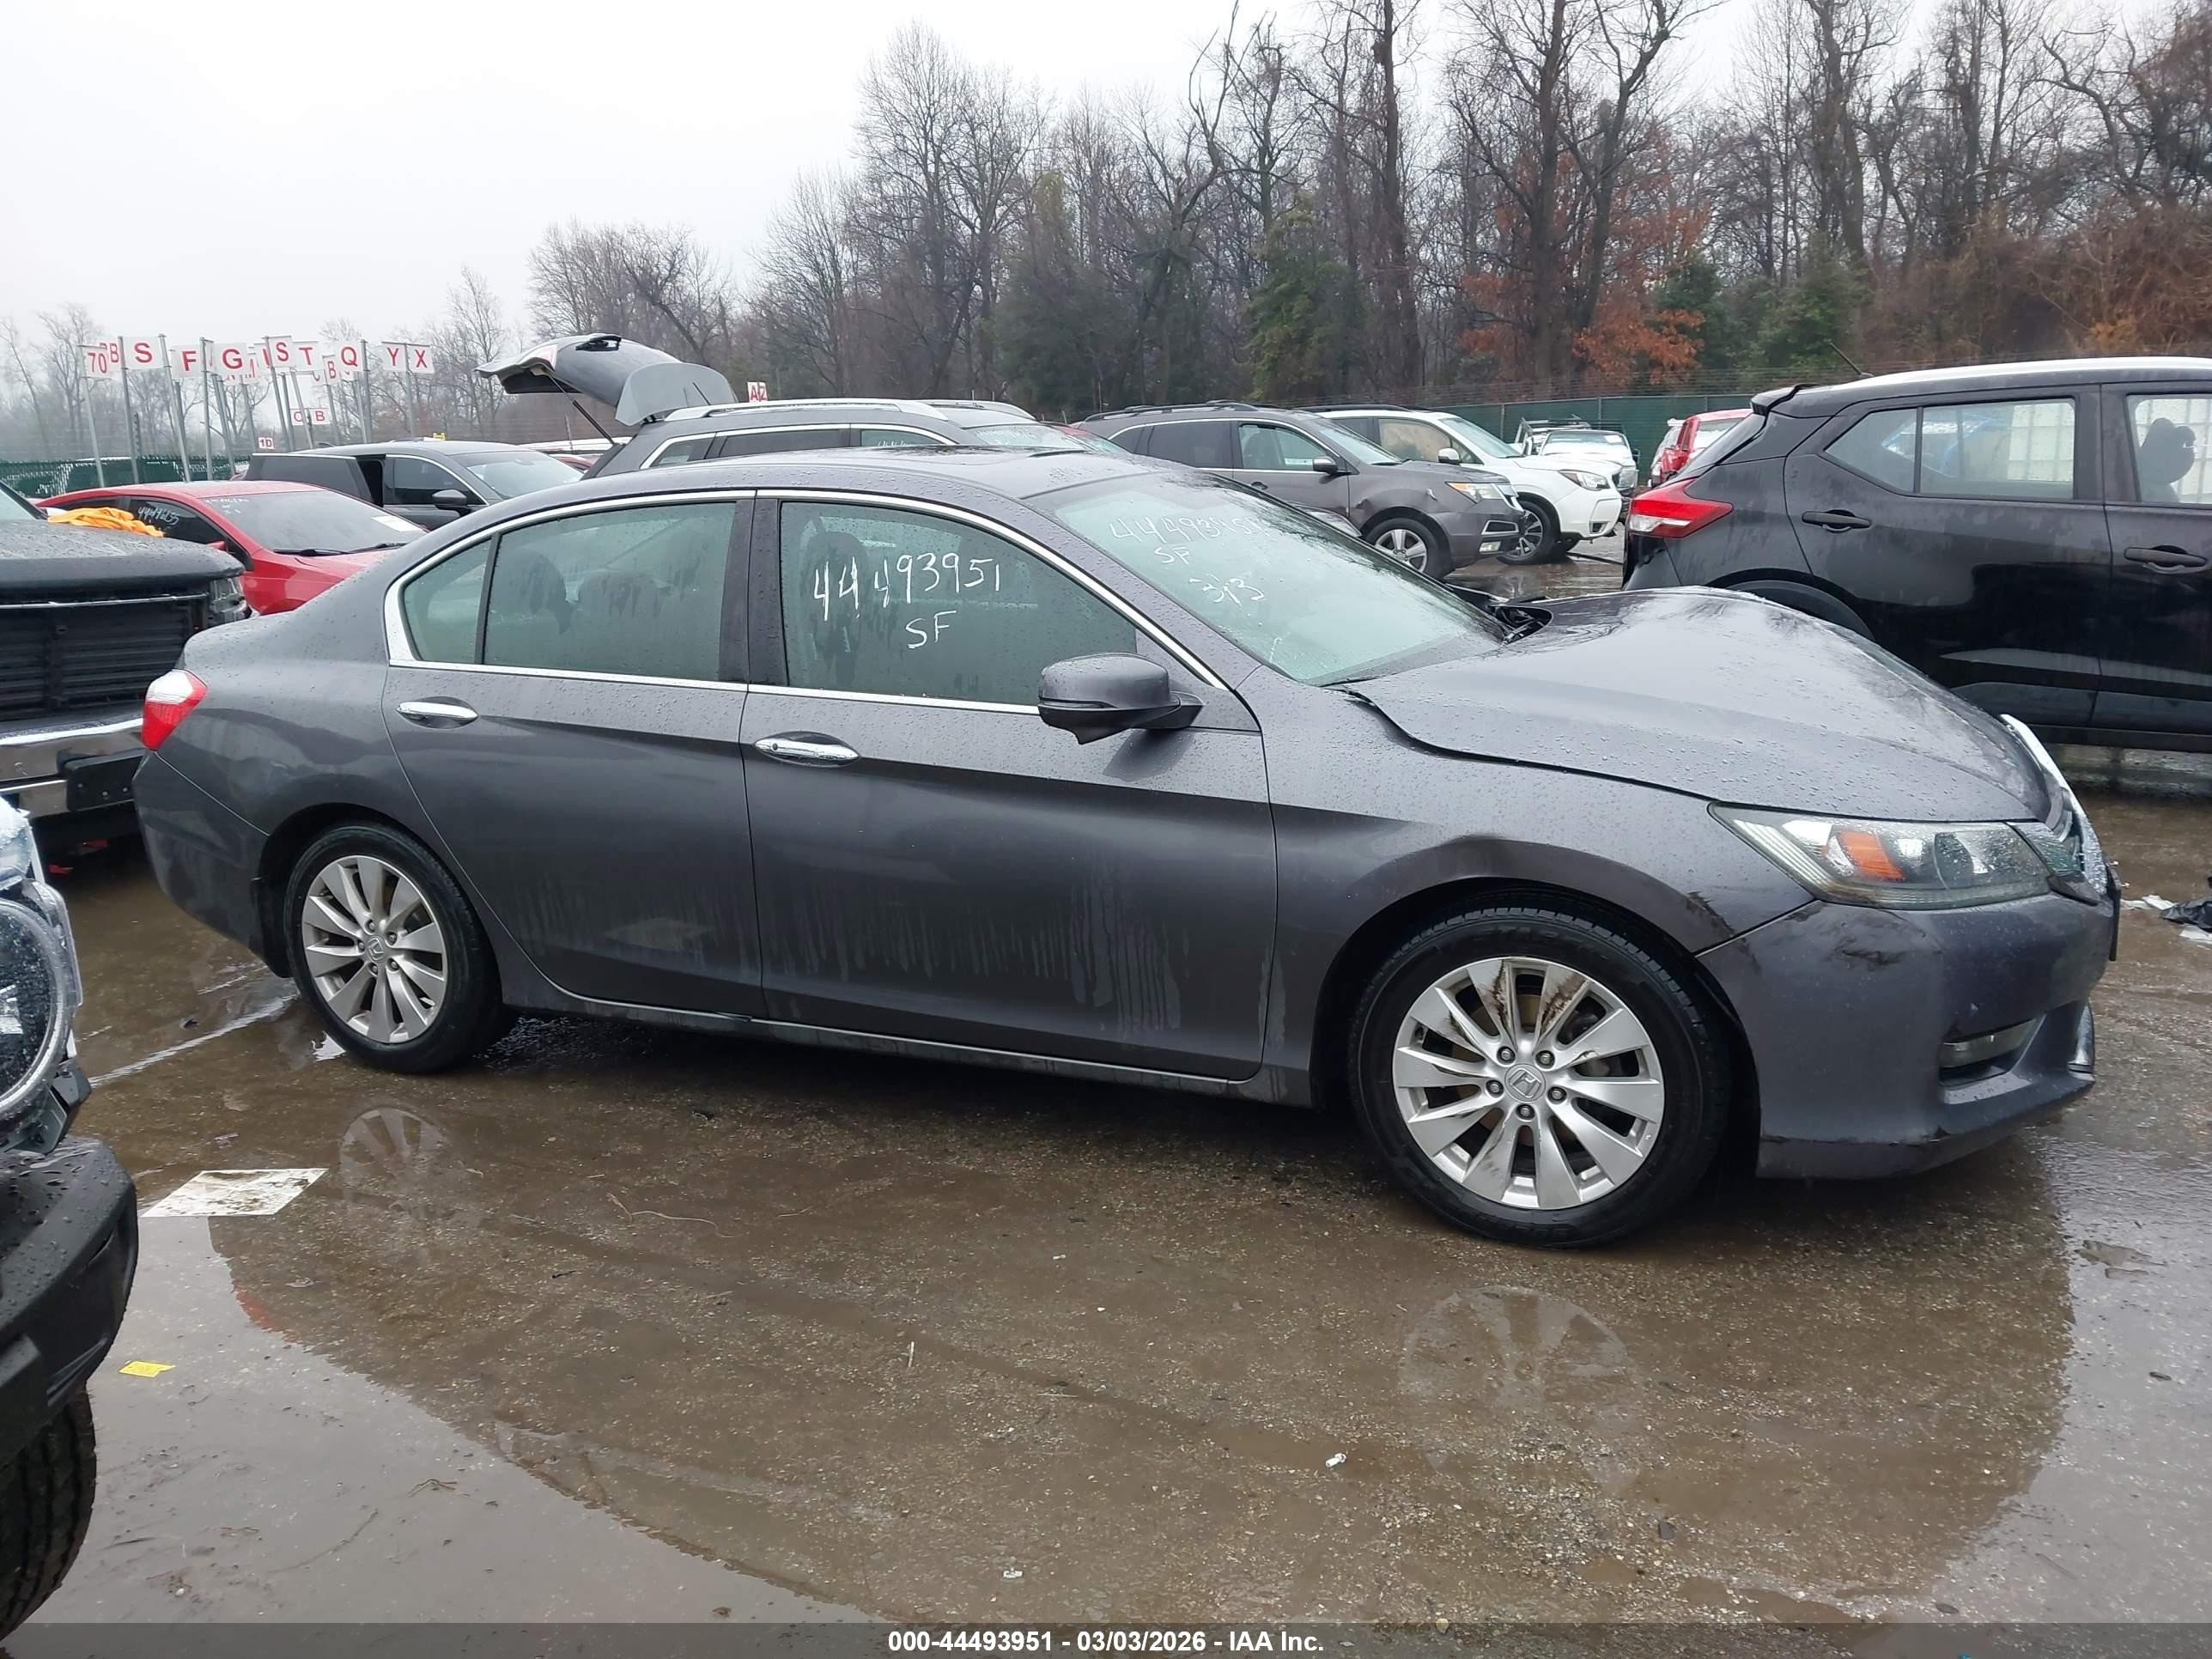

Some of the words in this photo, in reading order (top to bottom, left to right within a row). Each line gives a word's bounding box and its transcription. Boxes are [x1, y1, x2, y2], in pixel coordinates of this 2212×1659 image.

[134, 342, 153, 363] S
[181, 350, 197, 372] F
[222, 349, 243, 369] G
[276, 342, 289, 362] S
[298, 347, 313, 366] T
[340, 346, 358, 367] Q
[386, 347, 399, 367] Y
[415, 349, 428, 368] X
[88, 352, 107, 374] 70
[327, 361, 337, 379] B
[315, 410, 325, 422] B
[1154, 546, 1190, 565] SF
[813, 552, 1000, 622] 44493951
[904, 610, 957, 649] SF
